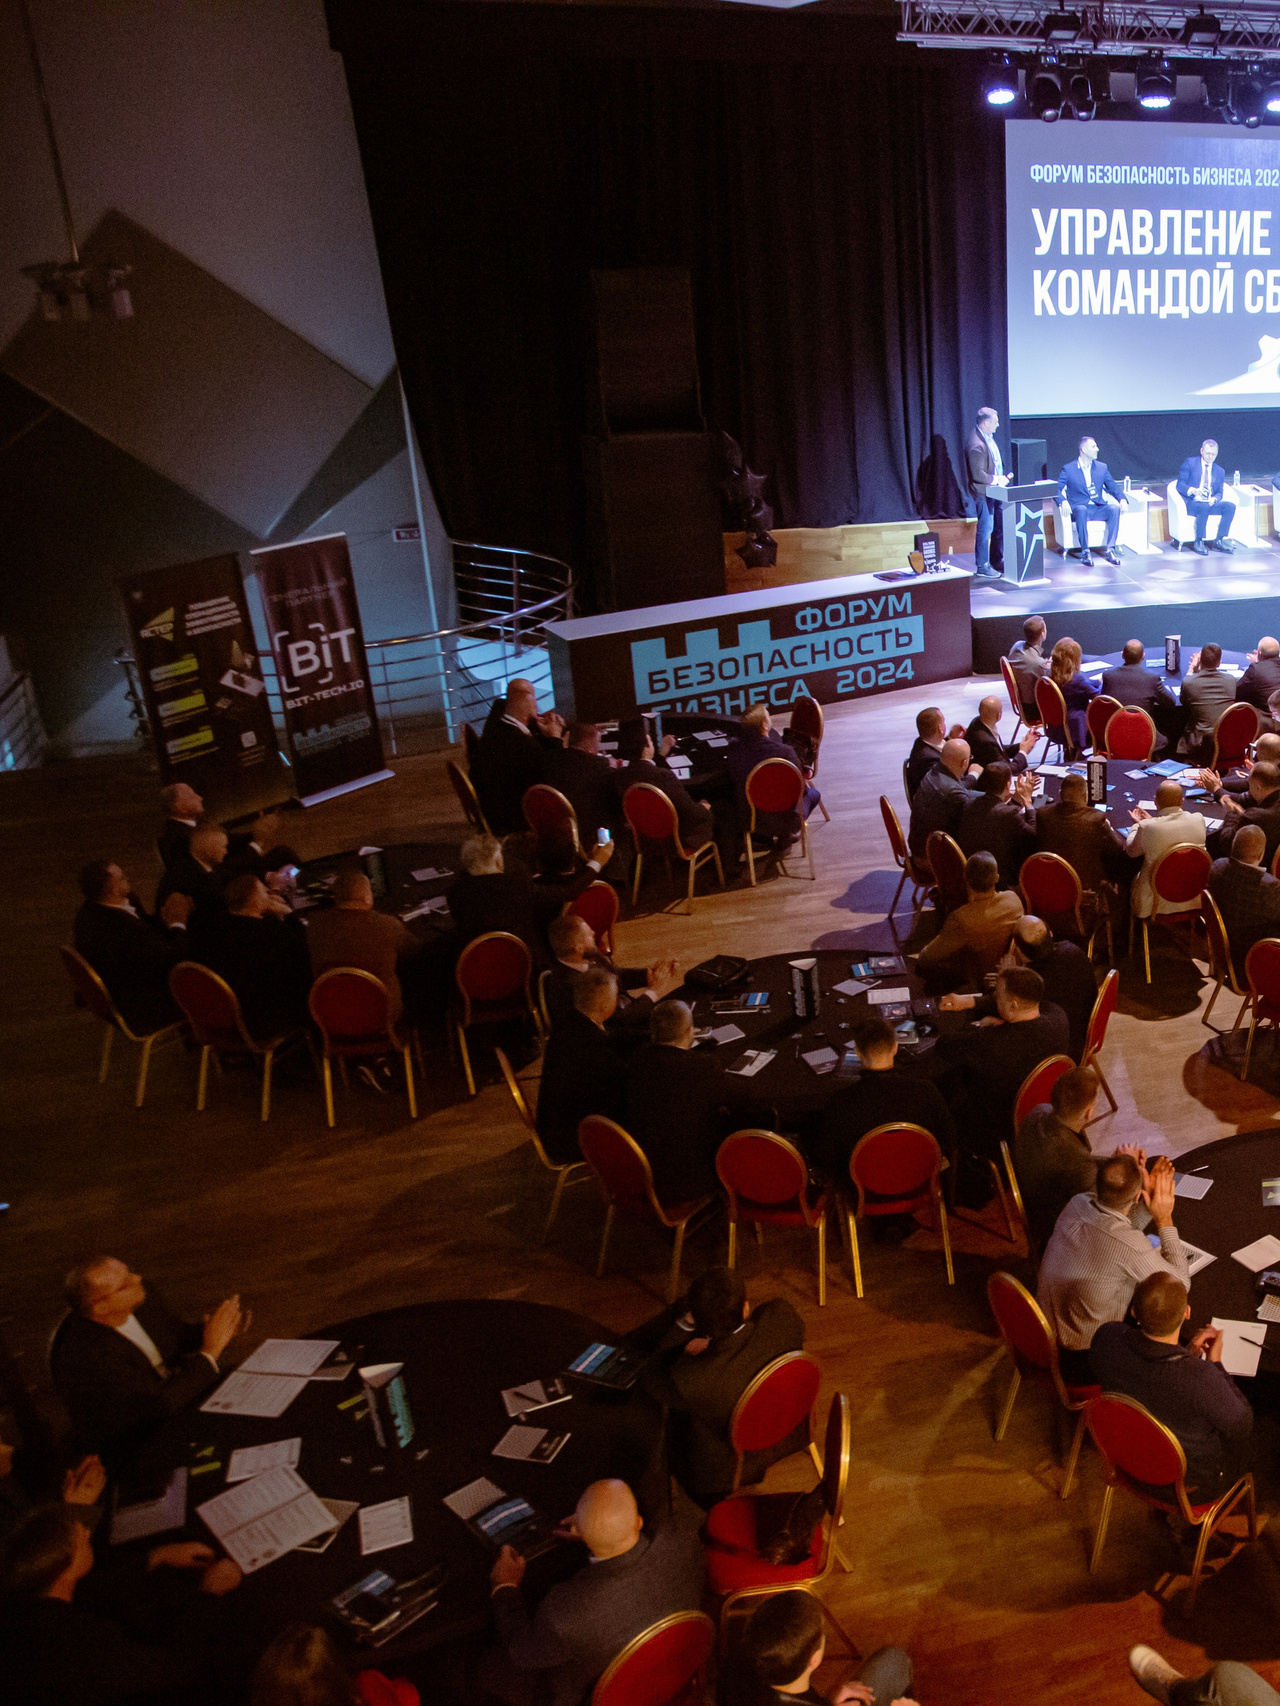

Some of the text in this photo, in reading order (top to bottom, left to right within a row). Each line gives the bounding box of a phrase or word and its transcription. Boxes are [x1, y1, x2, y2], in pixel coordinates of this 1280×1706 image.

[1030, 164, 1085, 185] ФОРУМ
[1086, 165, 1190, 186] БЕЗОПАСНОСТЬ
[1193, 167, 1252, 187] БИЗНЕСА
[1031, 207, 1272, 256] УПРАВЛЕНИЕ
[1032, 262, 1234, 319] КОМАНДОЙ
[795, 592, 912, 632] ФОРУМ
[288, 628, 356, 678] BiT
[648, 626, 914, 694] БЕЗОПАСНОСТЬ
[285, 679, 365, 710] BIT-TECH.IO
[836, 659, 915, 694] 2024
